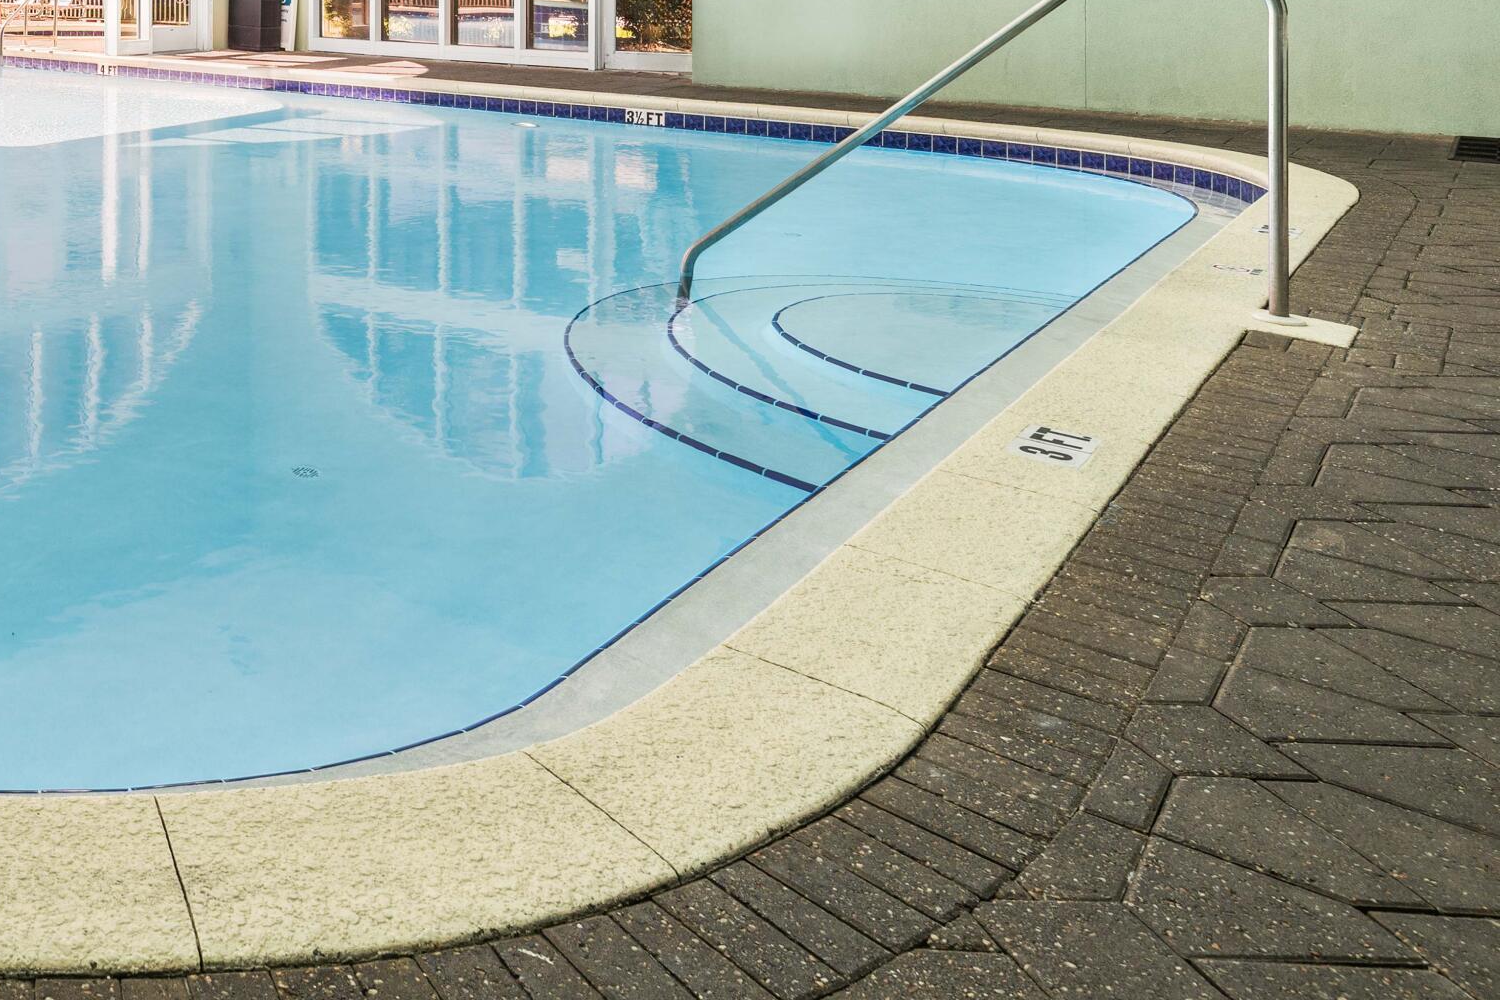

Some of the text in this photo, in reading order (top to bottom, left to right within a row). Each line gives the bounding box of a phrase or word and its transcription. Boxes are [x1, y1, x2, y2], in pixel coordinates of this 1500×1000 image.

[100, 64, 117, 76] 4 FT
[1019, 445, 1073, 461] 3
